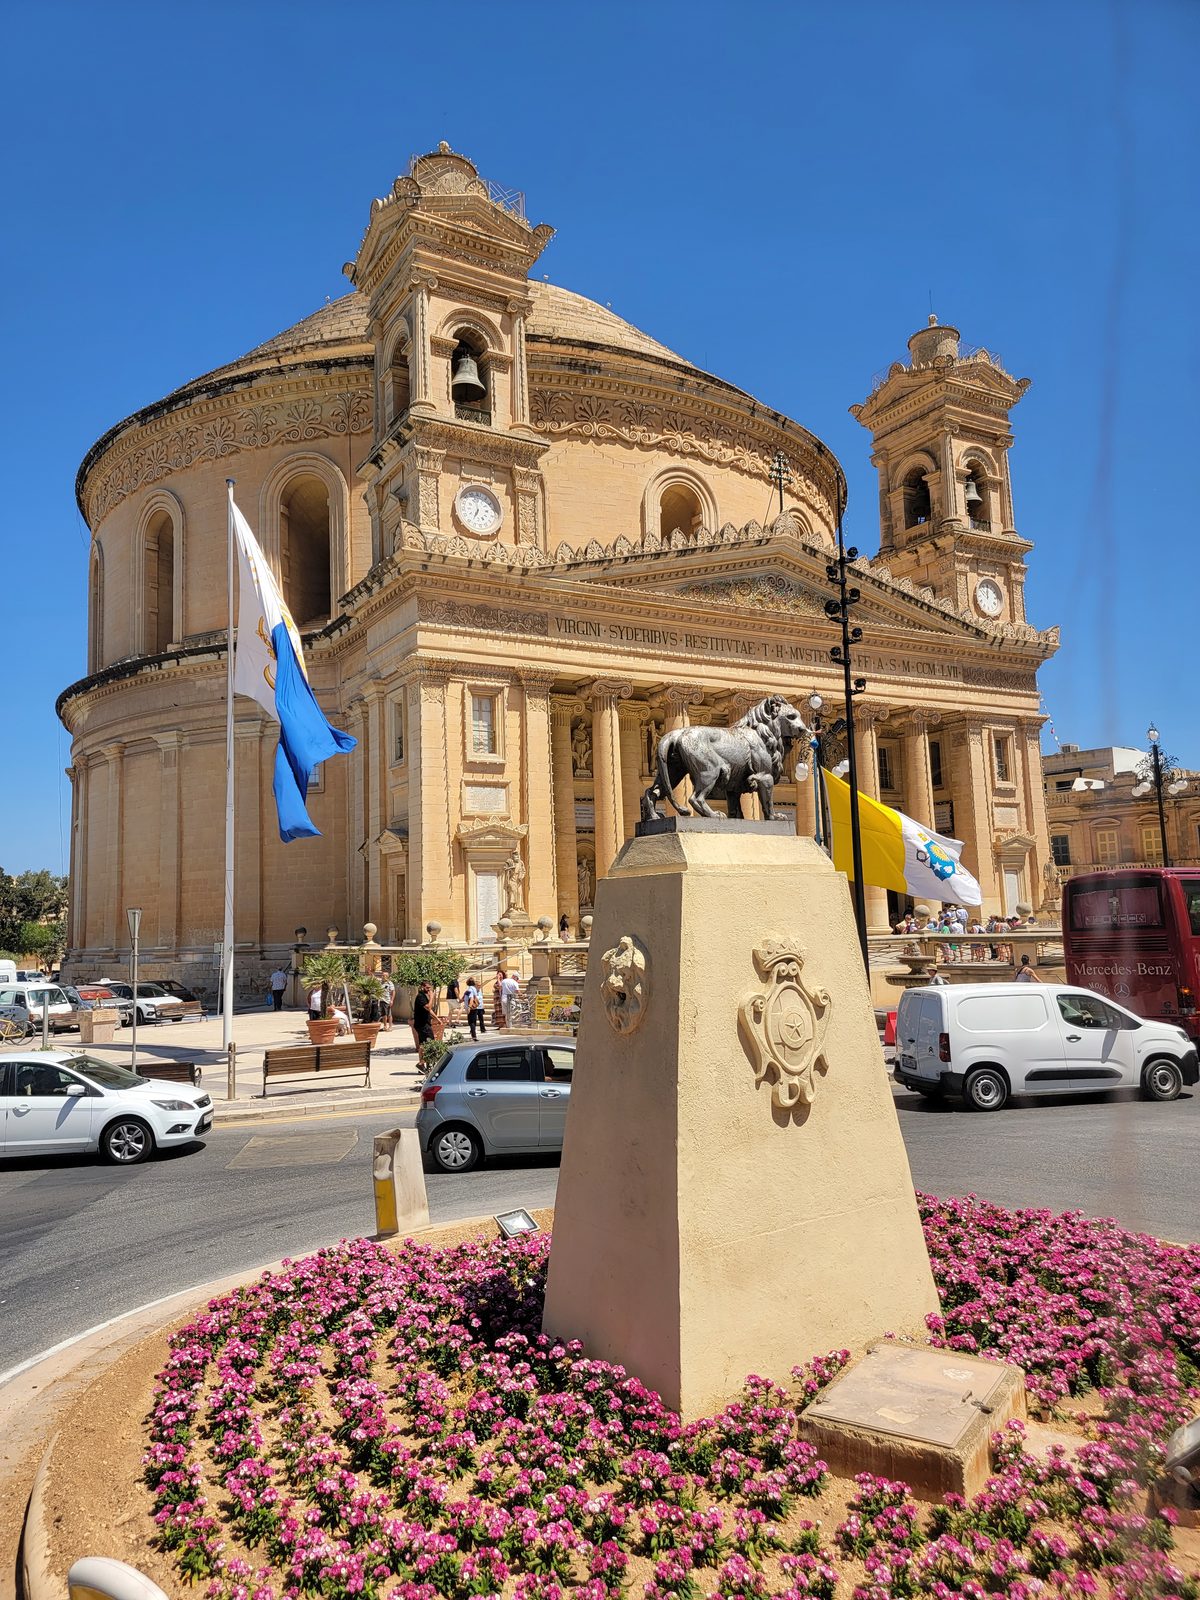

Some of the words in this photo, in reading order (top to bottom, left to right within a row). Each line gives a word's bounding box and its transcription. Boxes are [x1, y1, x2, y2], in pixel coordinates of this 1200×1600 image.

[554, 617, 601, 637] VIRGINI
[609, 625, 678, 647] SYDERIBVS
[685, 634, 756, 656] RESTITVTAE
[789, 646, 833, 664] MVSTEN
[1073, 962, 1172, 976] Mercedes-Benz
[1087, 981, 1111, 996] MOUNT
